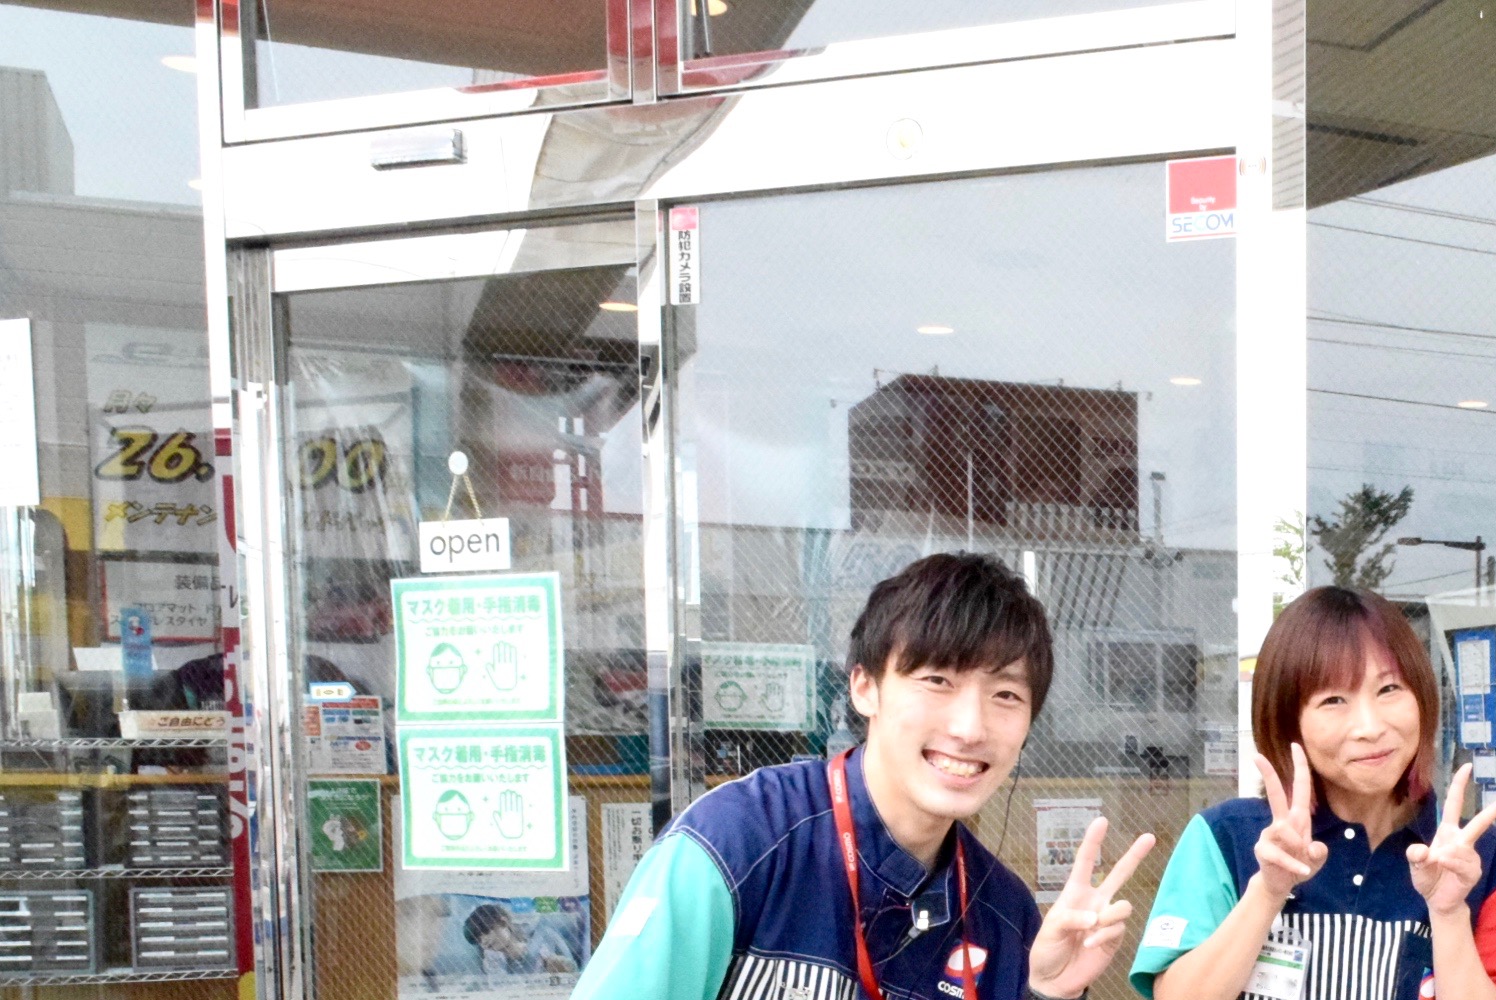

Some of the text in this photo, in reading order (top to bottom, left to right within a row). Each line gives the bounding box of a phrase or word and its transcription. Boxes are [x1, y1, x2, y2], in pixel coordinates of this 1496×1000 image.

[1172, 212, 1234, 233] SECOM
[678, 230, 691, 303] 防犯カメラ設置
[430, 533, 499, 563] open
[413, 745, 547, 763] マスク着用・手指消毒
